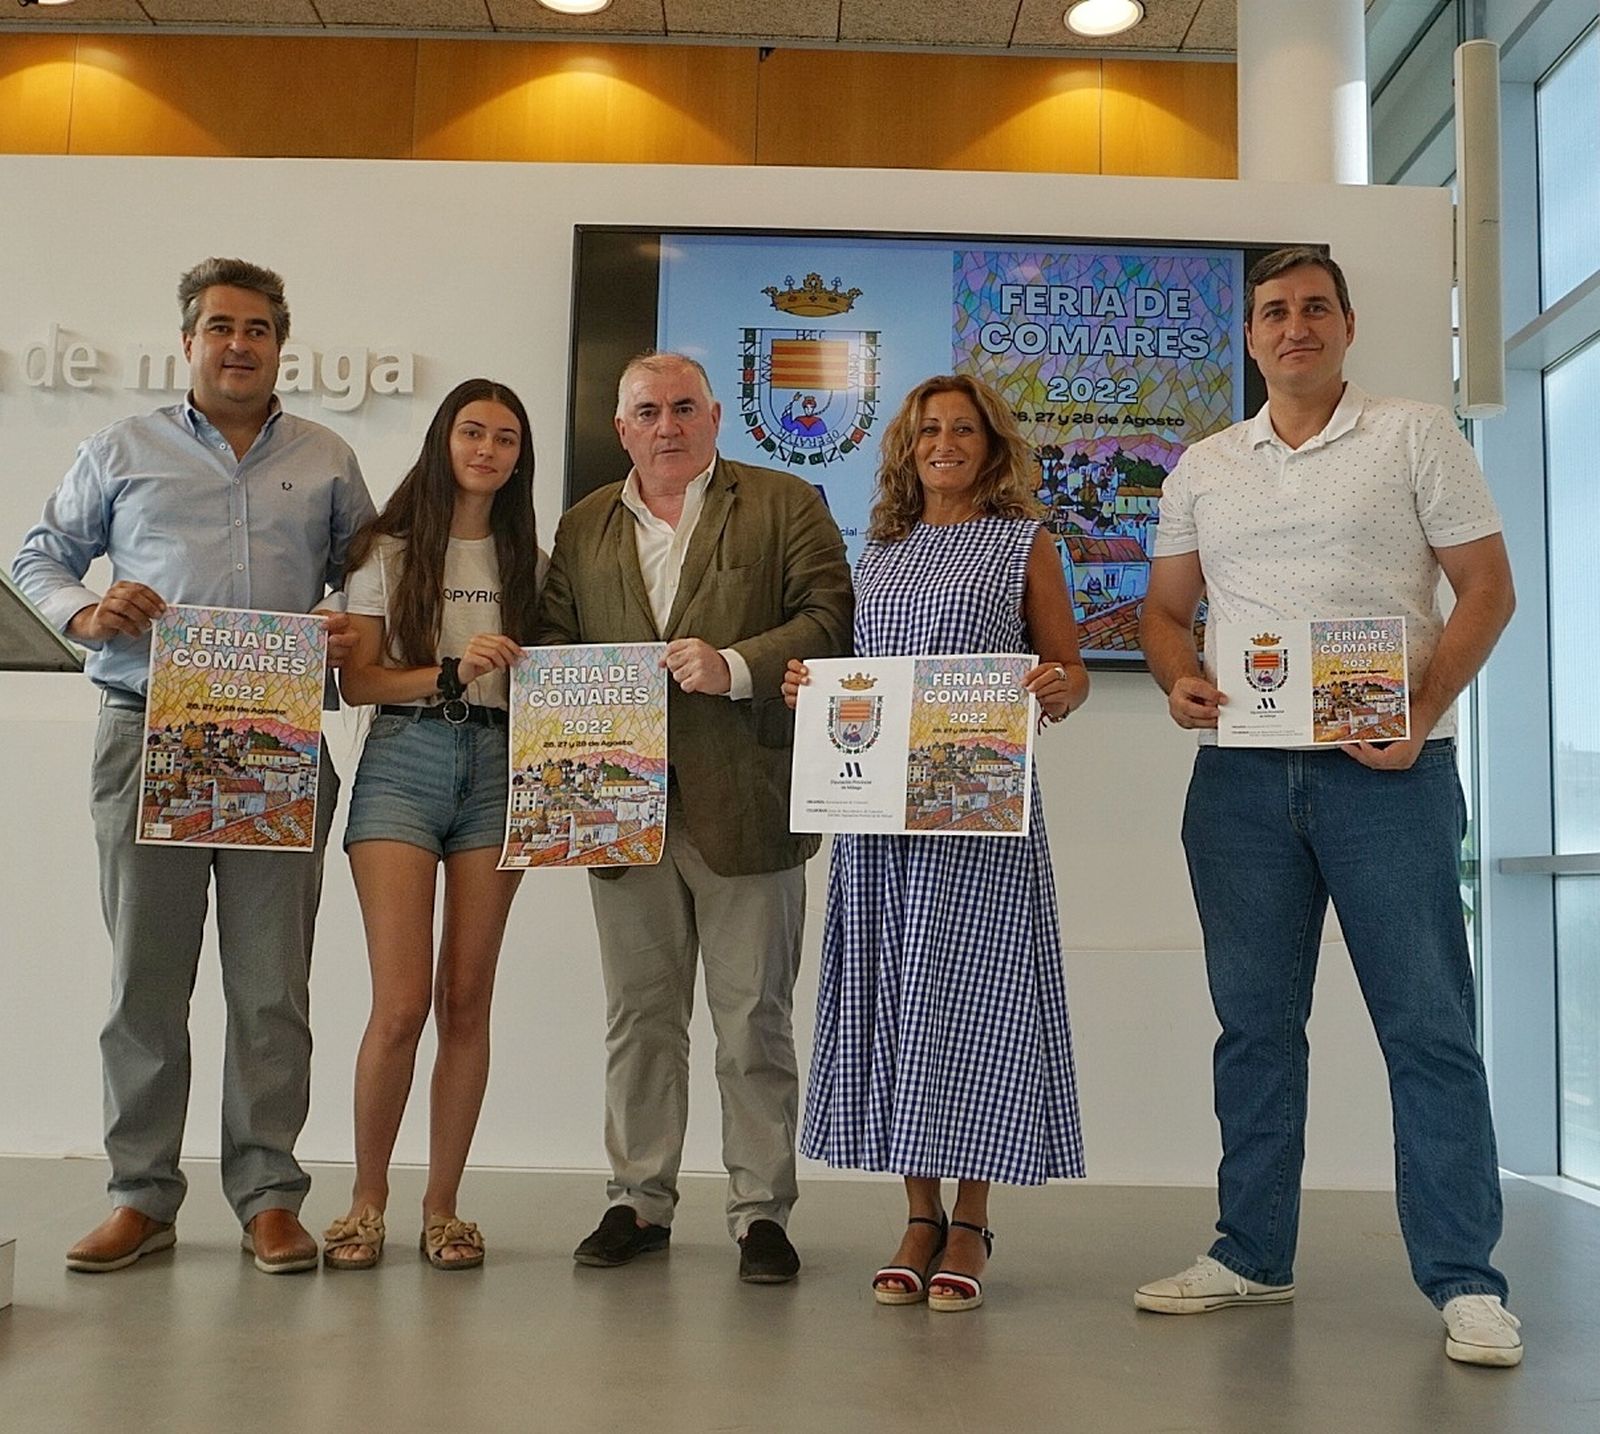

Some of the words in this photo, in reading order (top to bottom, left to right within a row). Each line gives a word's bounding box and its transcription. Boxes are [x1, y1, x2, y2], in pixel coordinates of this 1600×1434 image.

[1000, 283, 1127, 318] FERIA
[1135, 288, 1191, 320] DE
[979, 321, 1210, 360] COMARES
[21, 322, 97, 388] de
[1047, 376, 1140, 404] 2022
[1035, 411, 1056, 423] 27
[1058, 413, 1070, 426] y
[1072, 412, 1094, 424] 28
[1097, 413, 1119, 425] de
[1122, 414, 1185, 428] Agosto
[185, 626, 261, 649] FERIA
[264, 632, 298, 651] DE
[1326, 630, 1367, 642] FERIA
[1370, 629, 1389, 640] DE
[1320, 641, 1396, 654] COMARES
[171, 648, 308, 675] COMARES
[1343, 659, 1373, 668] 2022
[538, 665, 604, 686] FERIA
[607, 663, 639, 683] DE
[933, 671, 985, 687] FERIA
[988, 671, 1012, 686] DE
[208, 681, 266, 701] 2022
[527, 686, 651, 708] COMARES
[923, 688, 1020, 704] COMARES
[562, 718, 614, 736] 2022
[949, 712, 988, 724] 2022
[601, 740, 634, 748] Agosto
